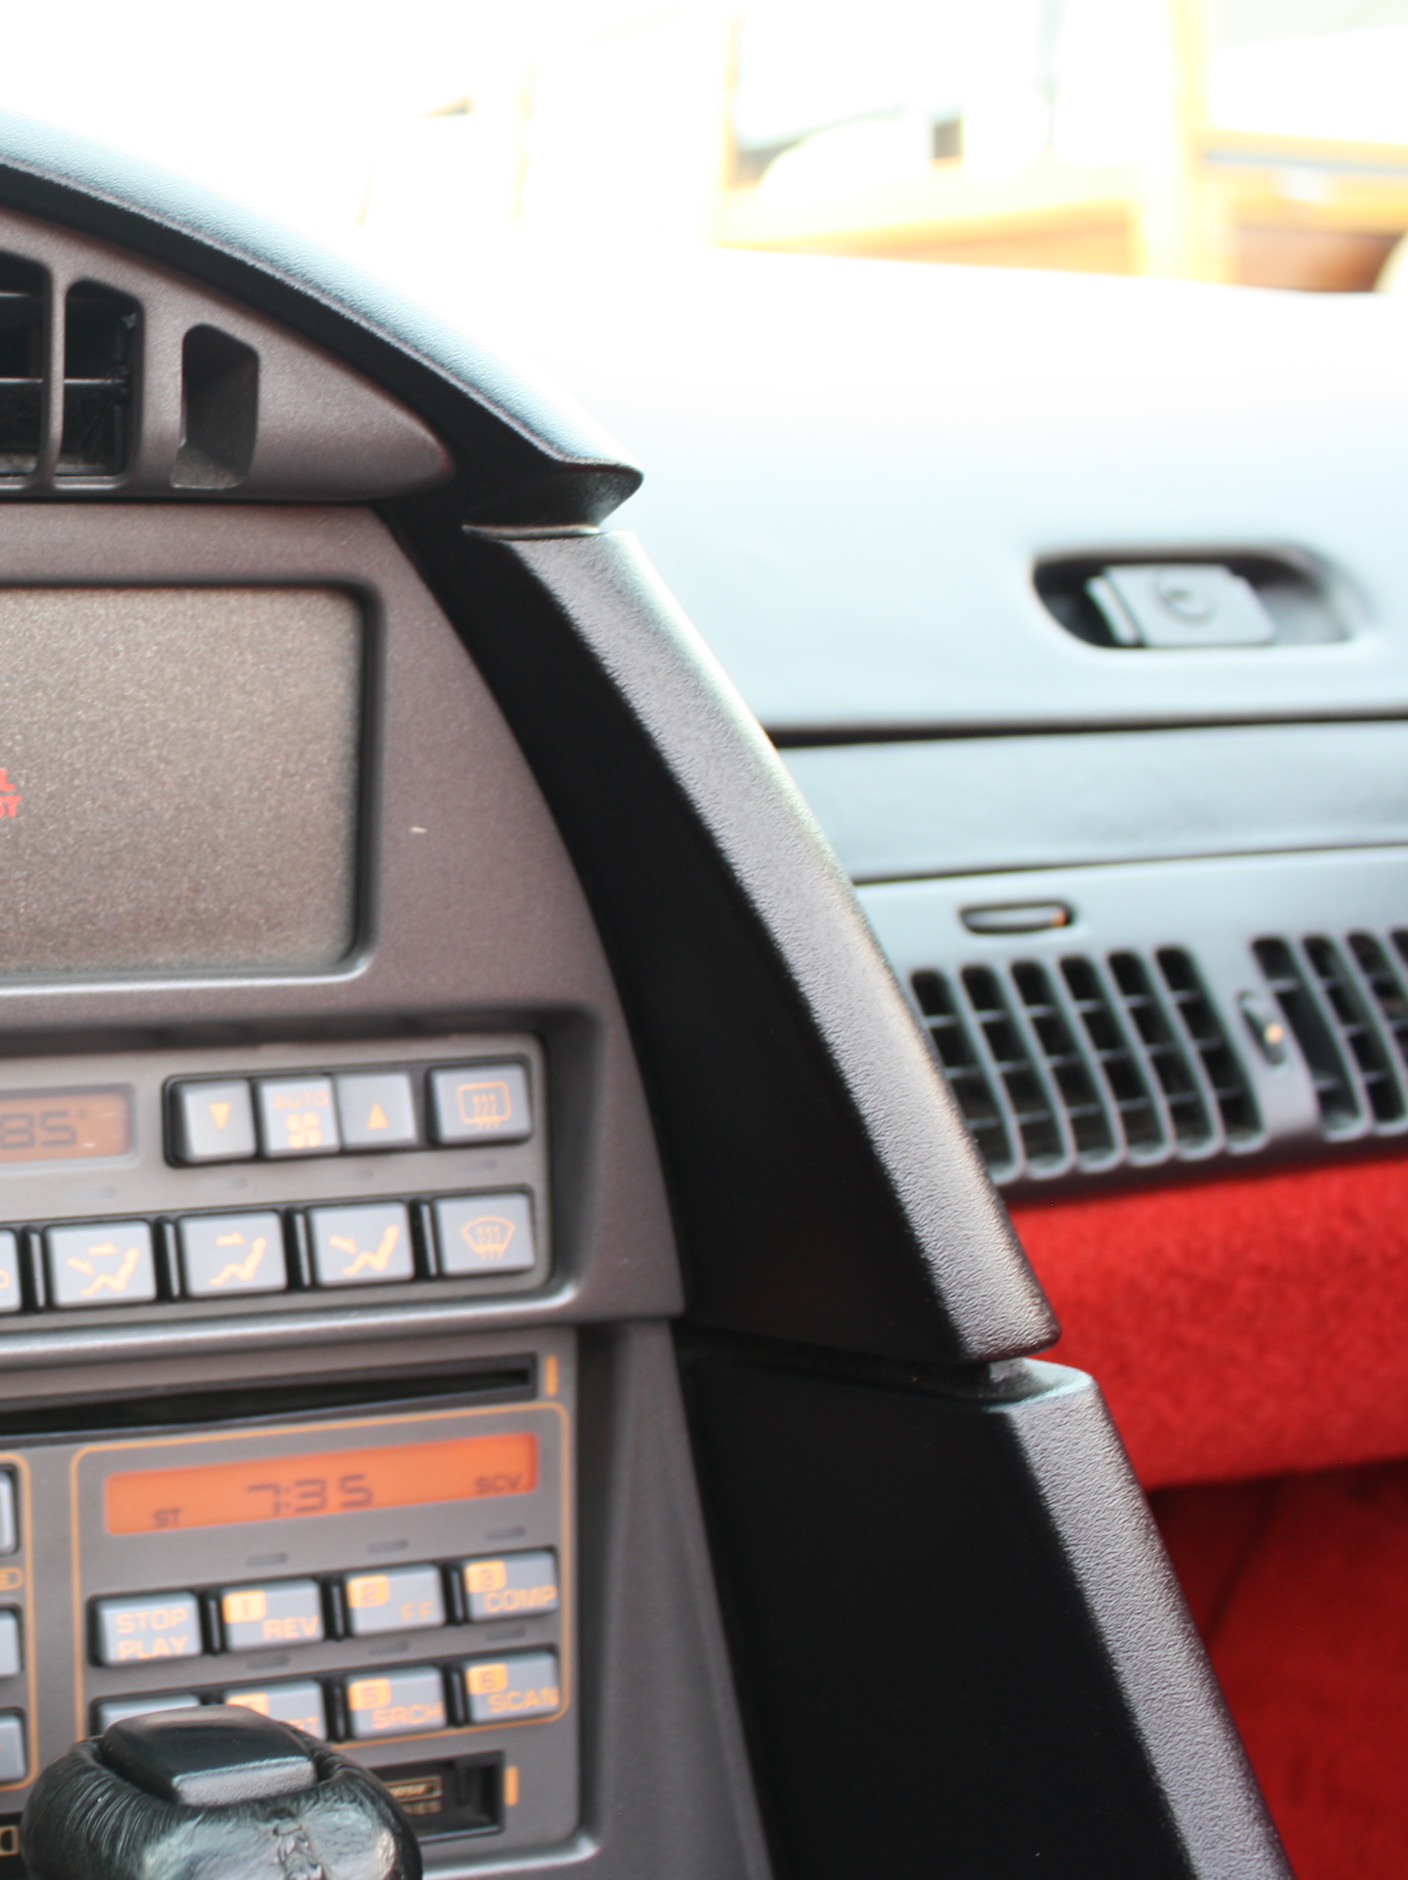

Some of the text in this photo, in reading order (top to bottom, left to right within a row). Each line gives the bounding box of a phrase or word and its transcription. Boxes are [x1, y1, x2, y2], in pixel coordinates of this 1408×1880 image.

[274, 1090, 329, 1110] AUTO
[245, 1473, 521, 1518] 7:35 SCV
[153, 1509, 182, 1527] ST
[483, 1585, 558, 1613] COMP
[115, 1608, 189, 1634] STOP
[263, 1616, 319, 1640] REV
[117, 1636, 189, 1660] PLAY
[488, 1687, 559, 1712] SCAN
[372, 1702, 445, 1729] SRCH
